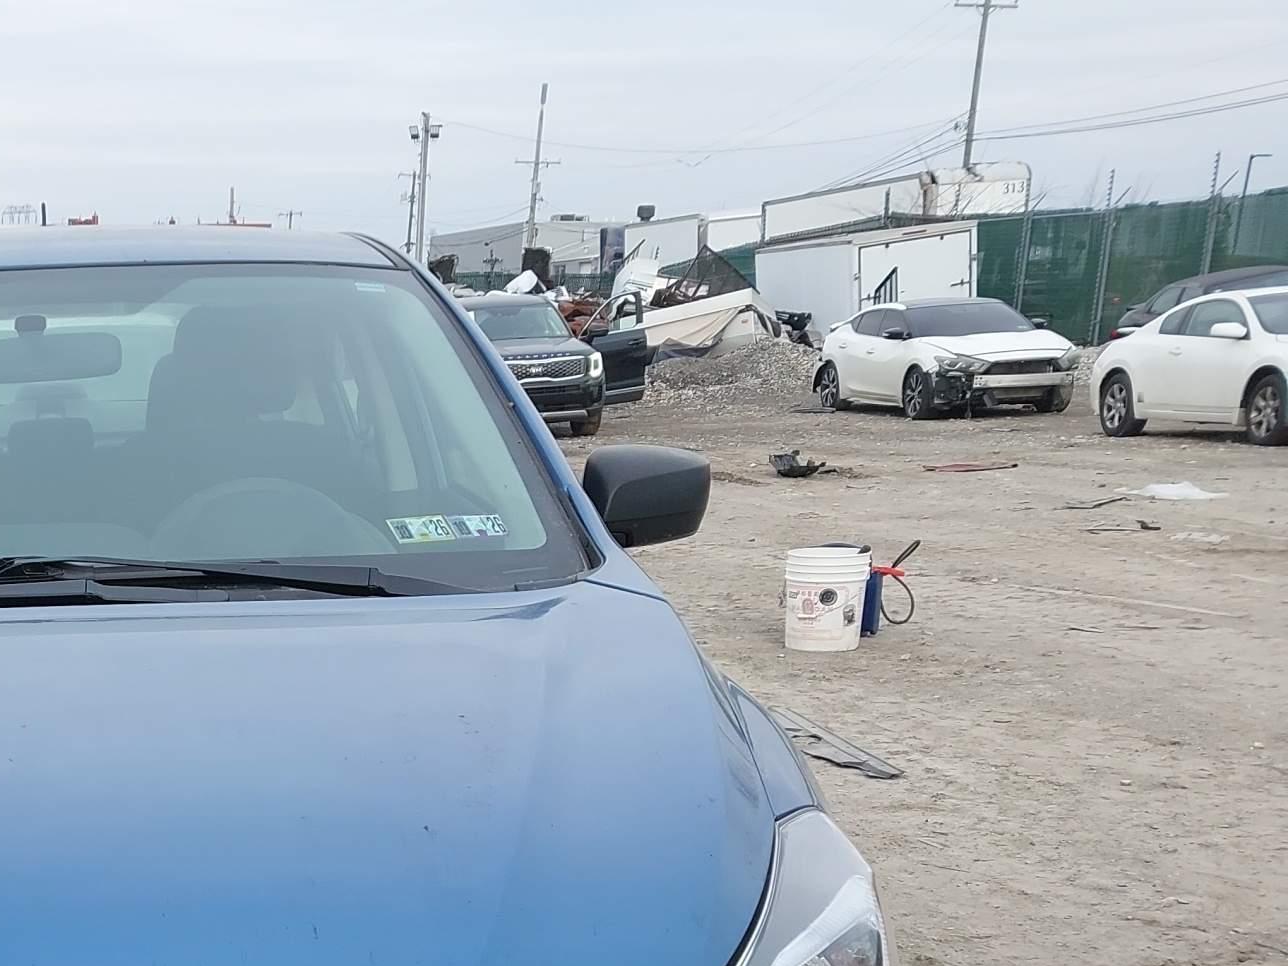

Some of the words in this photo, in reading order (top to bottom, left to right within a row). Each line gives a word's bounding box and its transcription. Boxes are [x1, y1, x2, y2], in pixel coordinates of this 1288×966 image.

[1003, 181, 1025, 195] 313
[430, 519, 450, 536] 26
[486, 516, 506, 534] 26
